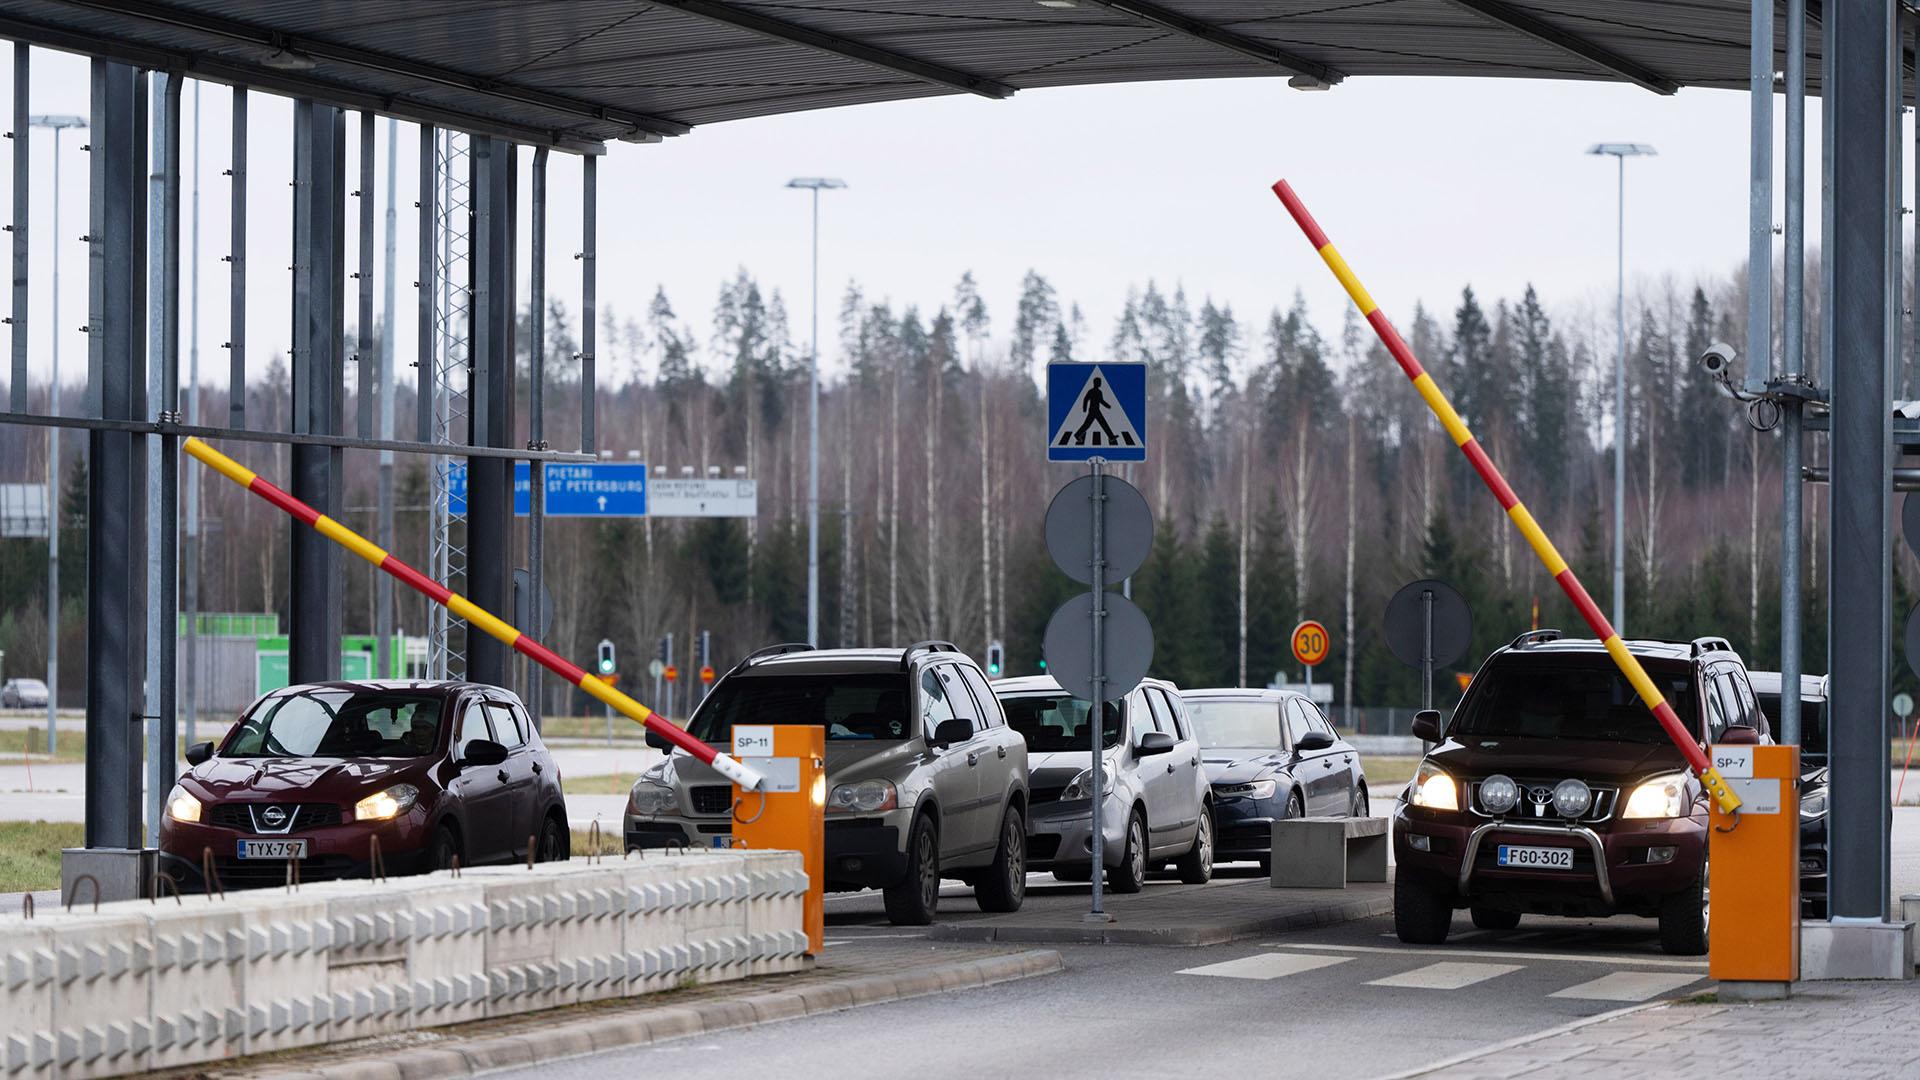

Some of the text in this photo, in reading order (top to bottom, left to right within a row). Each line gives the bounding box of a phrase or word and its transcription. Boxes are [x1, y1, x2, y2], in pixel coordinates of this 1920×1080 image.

[548, 467, 593, 479] PIETARI
[548, 480, 643, 492] ST PETERSBURG
[1300, 633, 1322, 654] 30
[738, 737, 768, 748] SP-11
[1717, 758, 1745, 768] SP-7
